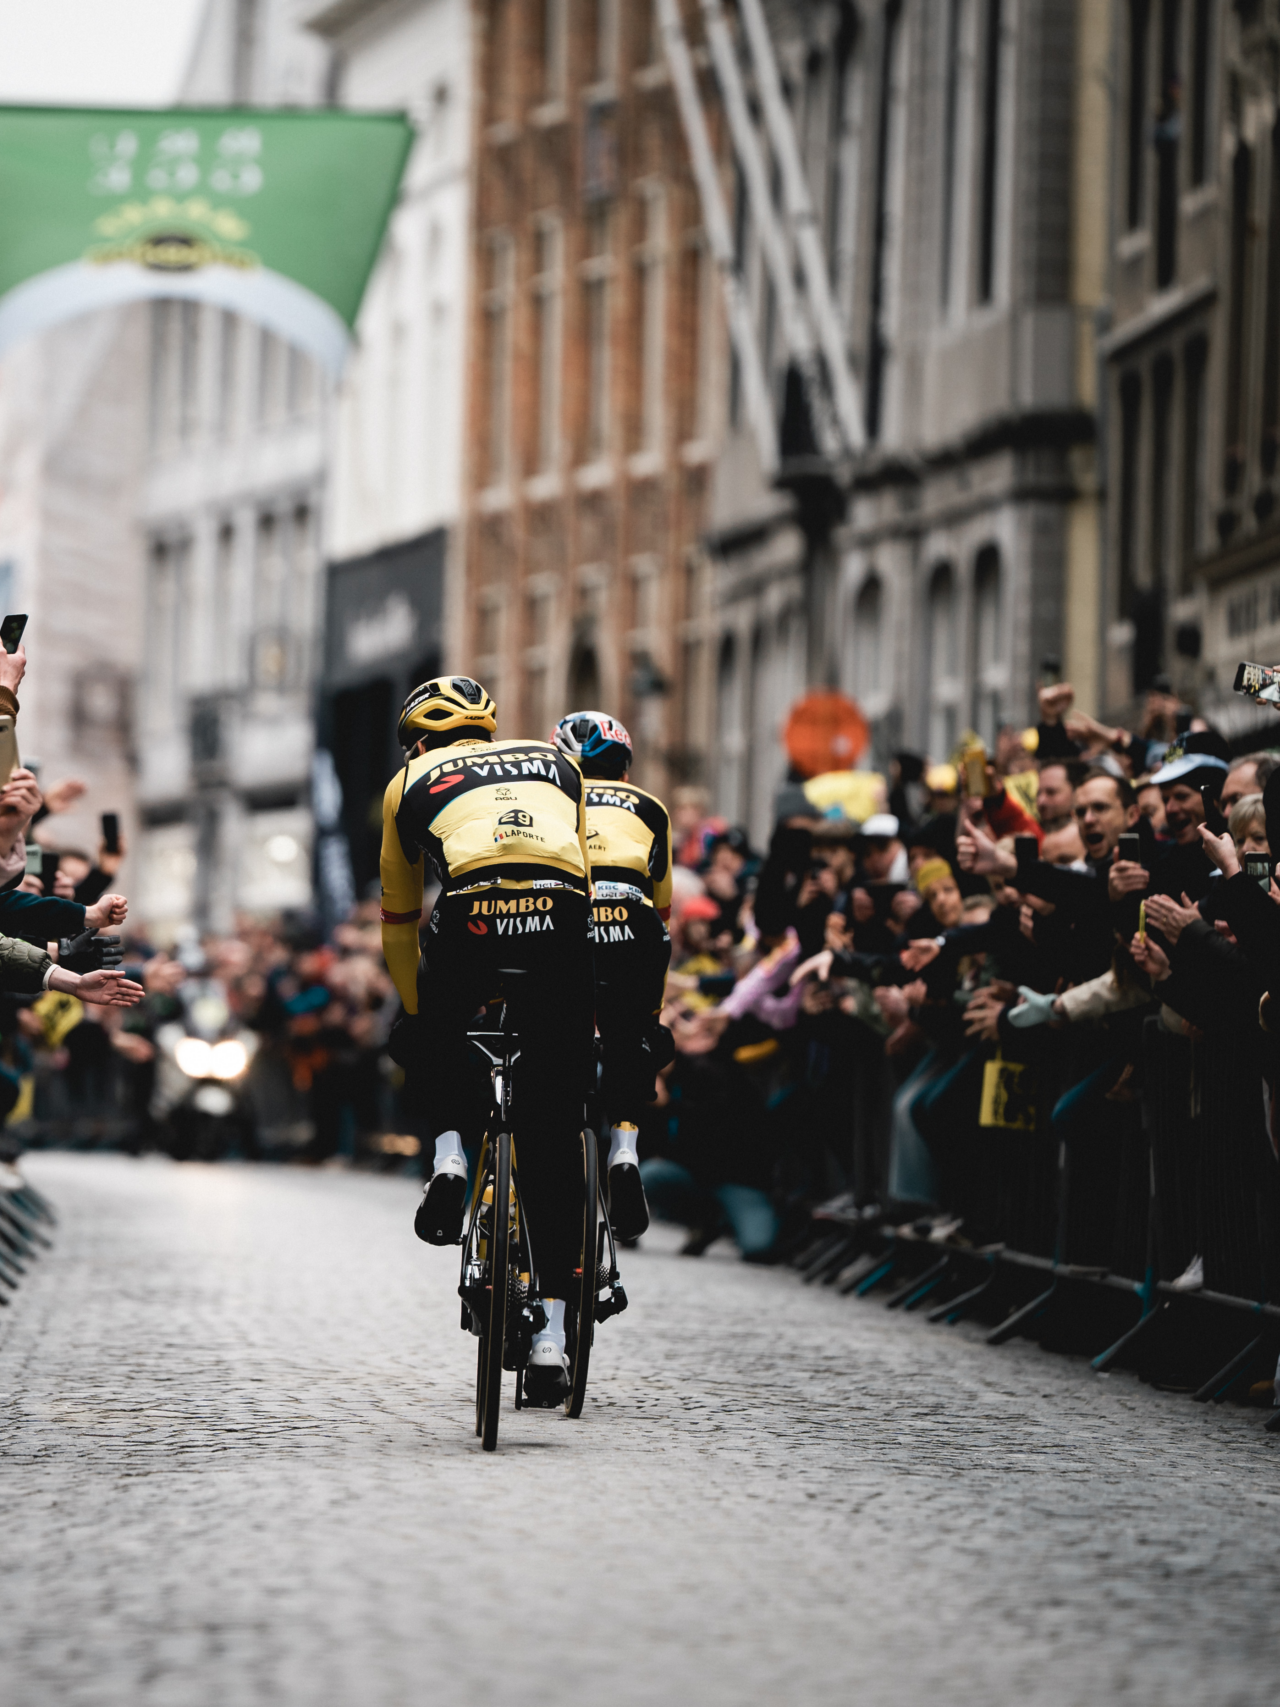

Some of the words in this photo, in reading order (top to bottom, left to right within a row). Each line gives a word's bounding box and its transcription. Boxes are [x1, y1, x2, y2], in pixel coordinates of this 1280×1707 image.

[426, 752, 557, 785] JUMBO
[471, 759, 561, 787] VISMA
[500, 811, 531, 826] 29
[504, 829, 546, 843] LAPORTE
[469, 896, 554, 915] JUMBO
[496, 915, 555, 935] VISMA
